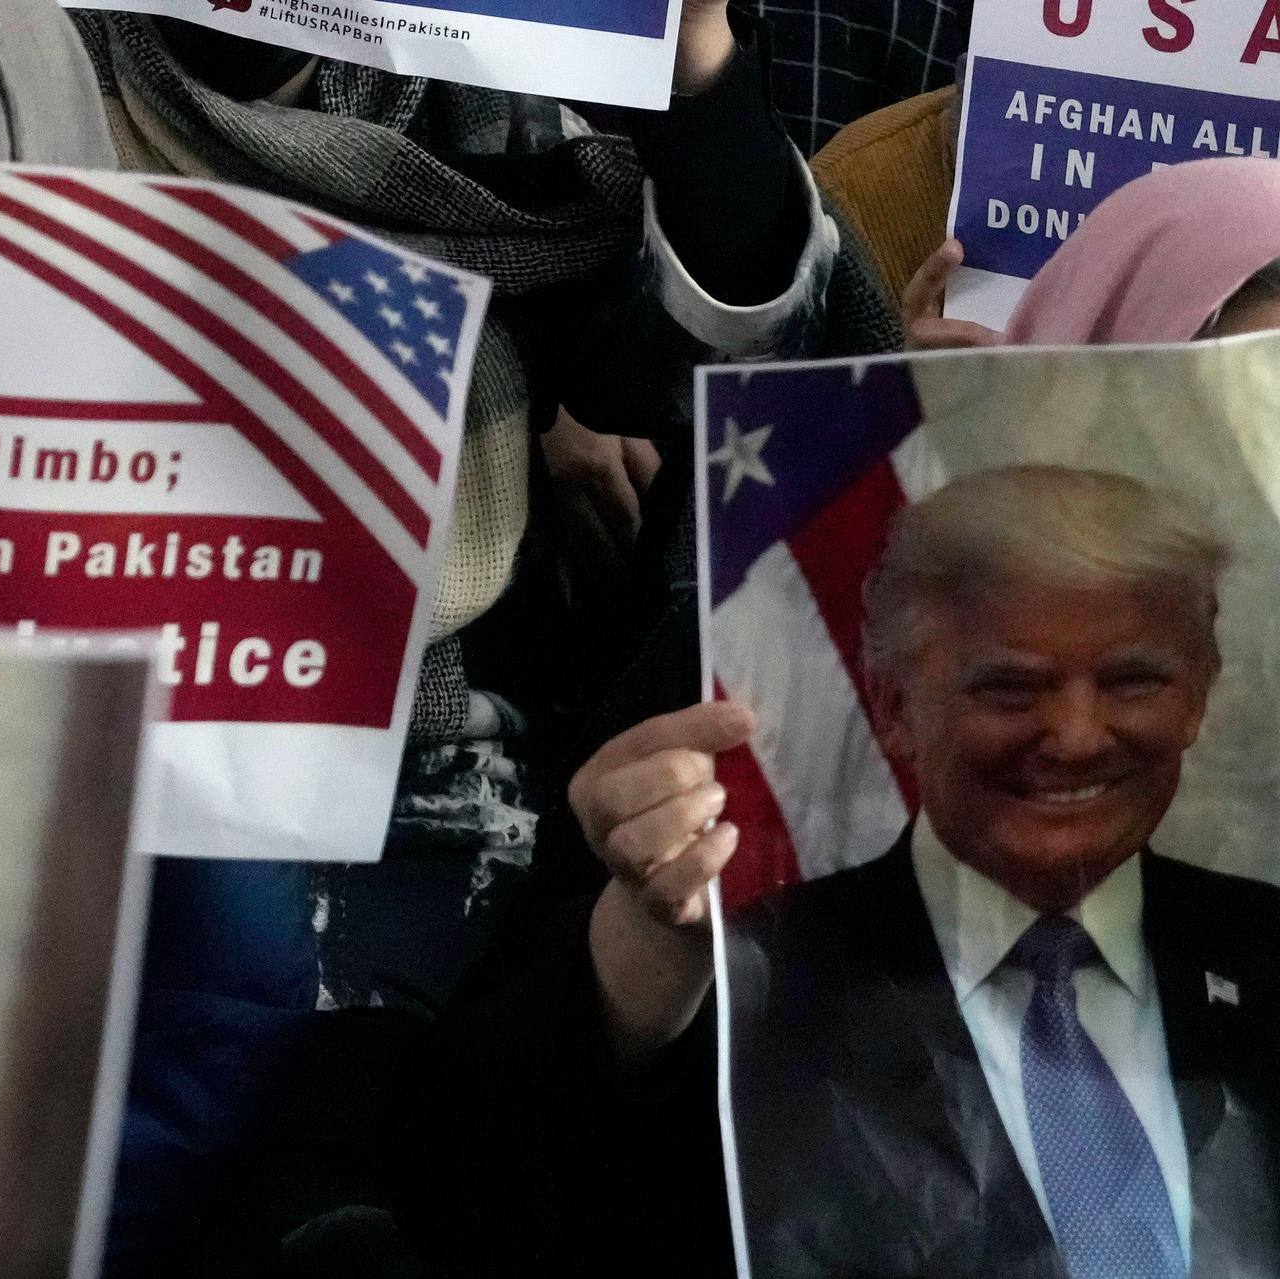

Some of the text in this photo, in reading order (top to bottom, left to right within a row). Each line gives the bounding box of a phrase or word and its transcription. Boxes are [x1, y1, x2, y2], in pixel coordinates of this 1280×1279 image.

[258, 5, 384, 46] #LiftUSRAPBan
[1004, 89, 1175, 145] AFGHAN
[1030, 143, 1096, 189] IN
[42, 531, 325, 586] Pakistan
